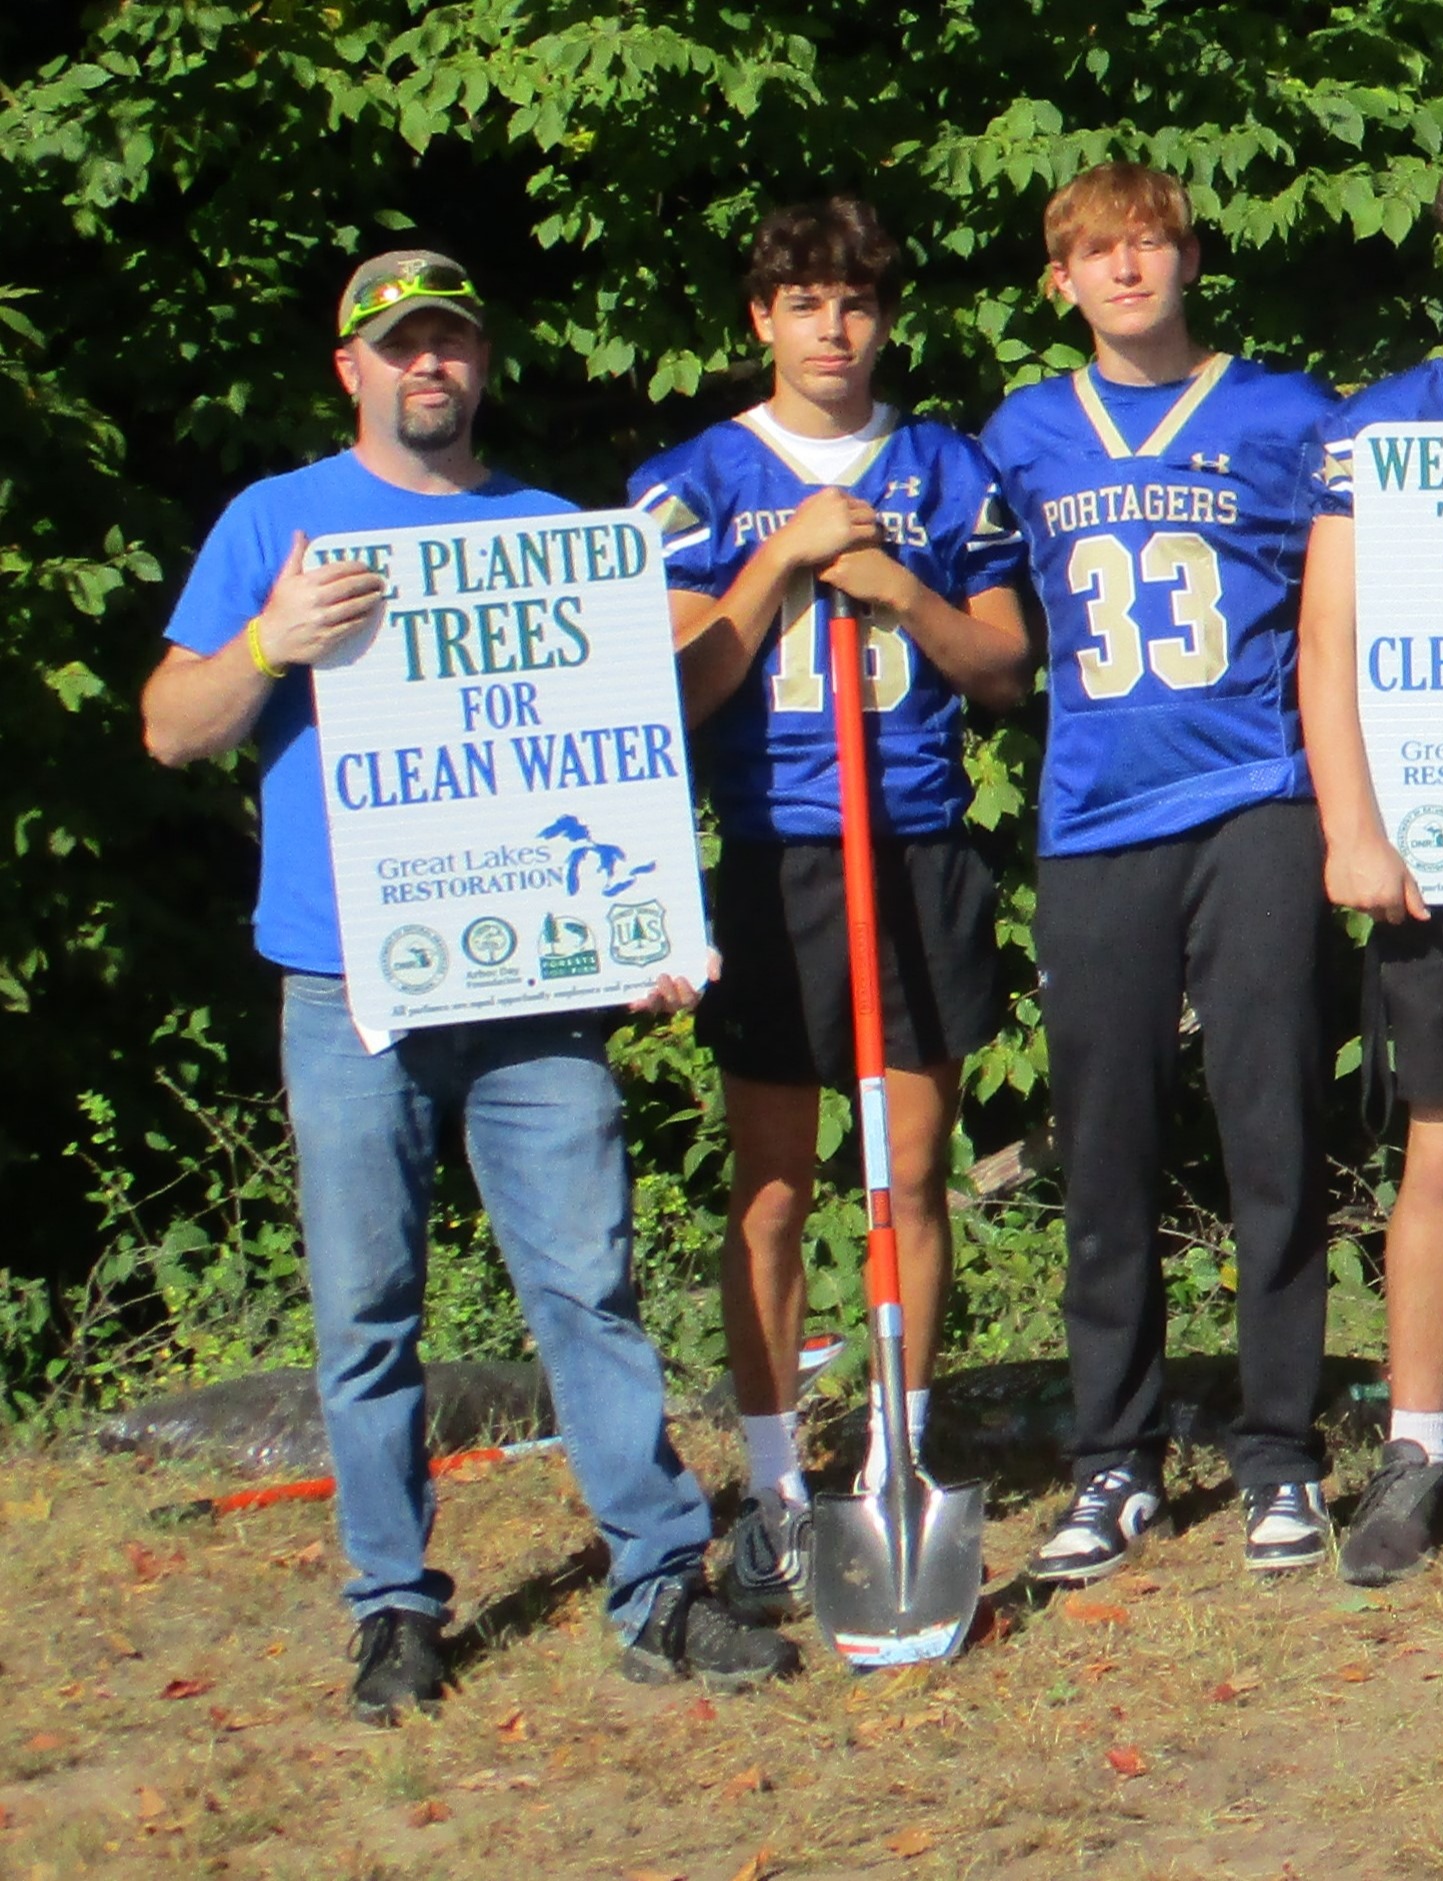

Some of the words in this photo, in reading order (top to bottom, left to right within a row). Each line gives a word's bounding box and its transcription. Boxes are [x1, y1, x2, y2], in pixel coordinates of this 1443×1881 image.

[1043, 484, 1238, 537] PORTAGERS
[419, 523, 648, 596] PLANTED
[390, 596, 590, 682] TREES
[1067, 532, 1229, 699] 33
[460, 682, 542, 732] FOR
[335, 740, 498, 811] CLEAN
[511, 723, 679, 793] WATER
[377, 852, 456, 881] Great
[465, 845, 551, 872] Lakes
[381, 866, 565, 905] RESTORATION
